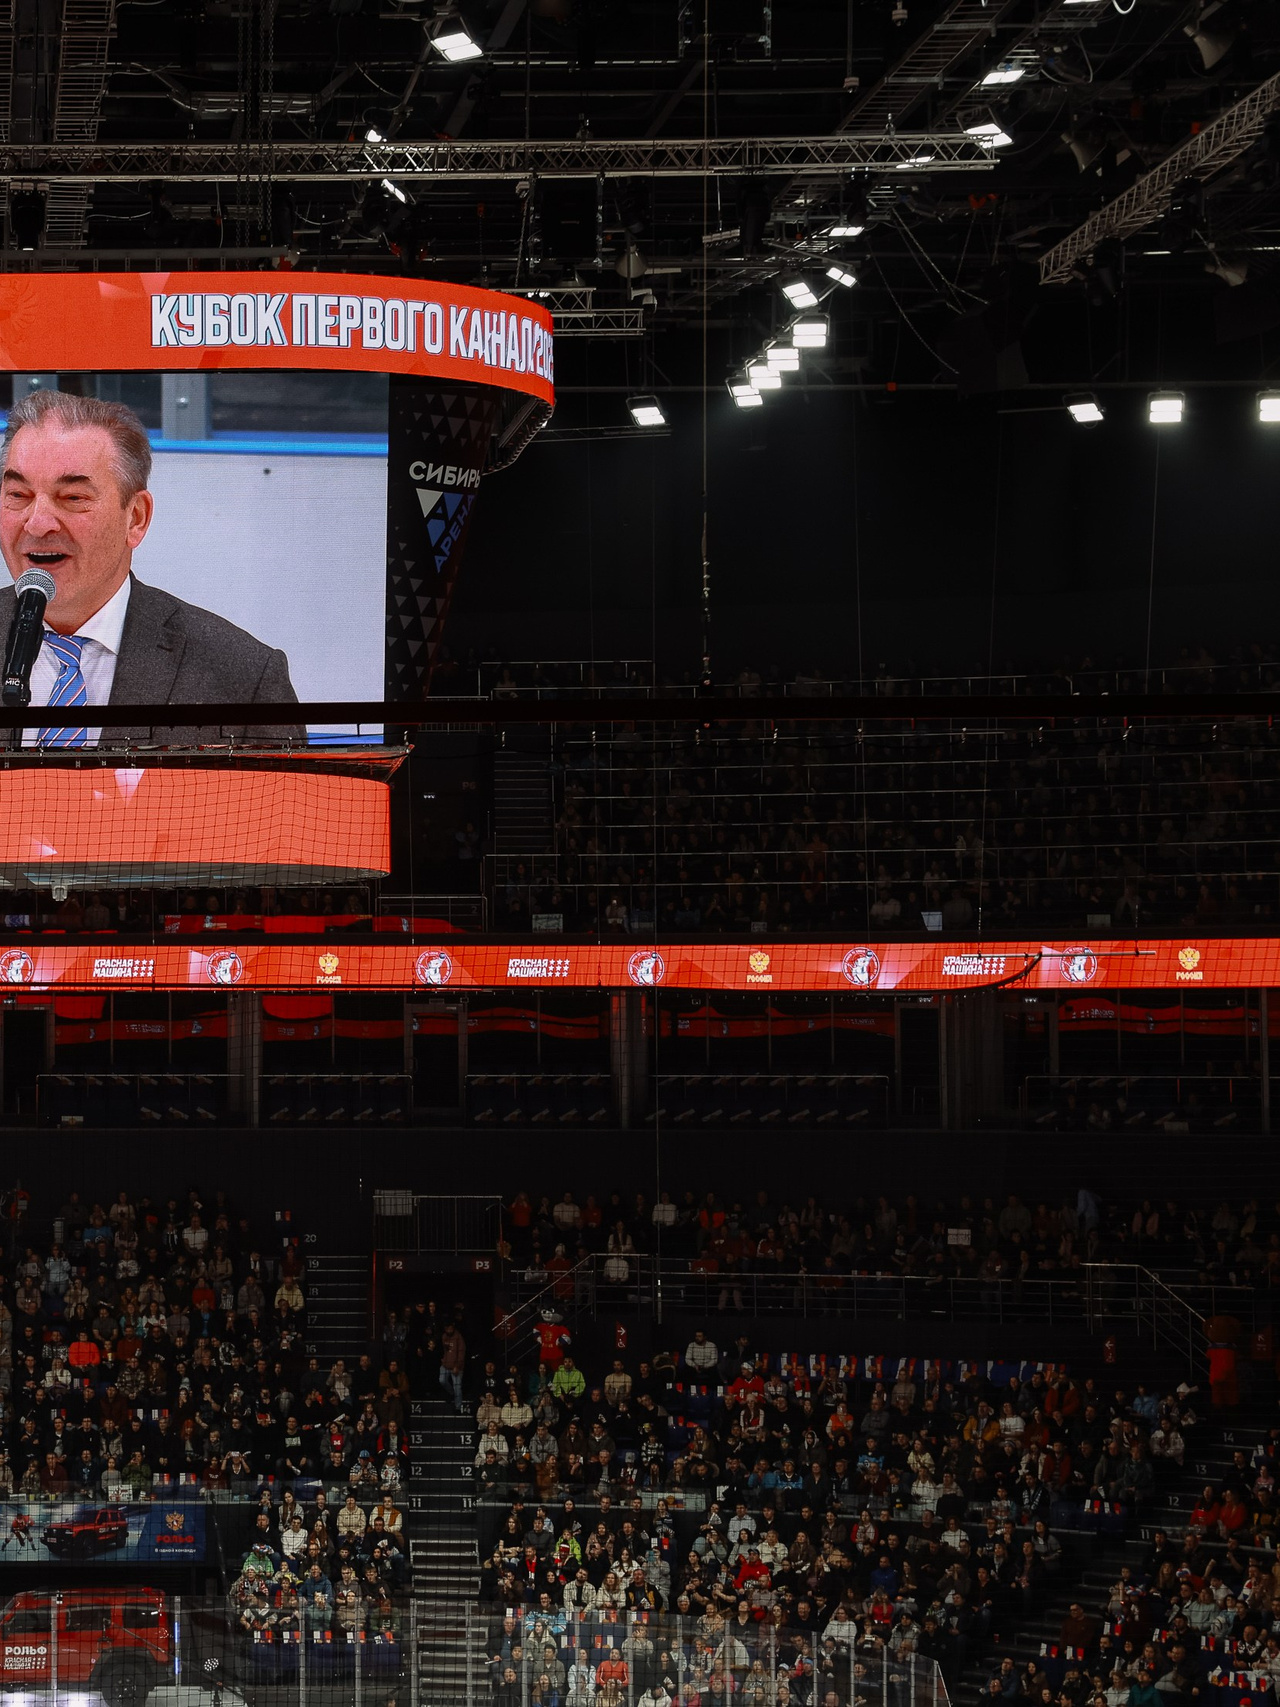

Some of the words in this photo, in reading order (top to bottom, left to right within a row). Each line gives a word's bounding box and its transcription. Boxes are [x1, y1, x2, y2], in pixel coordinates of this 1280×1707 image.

[151, 294, 286, 347] КУБОК
[291, 294, 443, 355] ПЕРВОГО
[409, 461, 480, 488] СИБИРЬ
[95, 959, 134, 967] КРАСНАЯ
[509, 959, 548, 967] КРАСНАЯ
[93, 967, 132, 977] МАШИНА
[507, 967, 547, 977] МАШИНА
[942, 965, 983, 975] МАШИНА
[389, 1261, 403, 1269] P2
[476, 1261, 490, 1269] P3
[411, 1404, 421, 1413] 14
[411, 1435, 422, 1444] 13
[460, 1435, 472, 1444] 13
[411, 1466, 422, 1475] 12
[460, 1467, 472, 1476] 12
[1195, 1464, 1207, 1474] 13
[412, 1498, 421, 1507] 11
[462, 1498, 472, 1508] 11
[1168, 1496, 1179, 1506] 12
[1140, 1529, 1150, 1539] 11
[5, 1646, 47, 1655] РОЛЬФ
